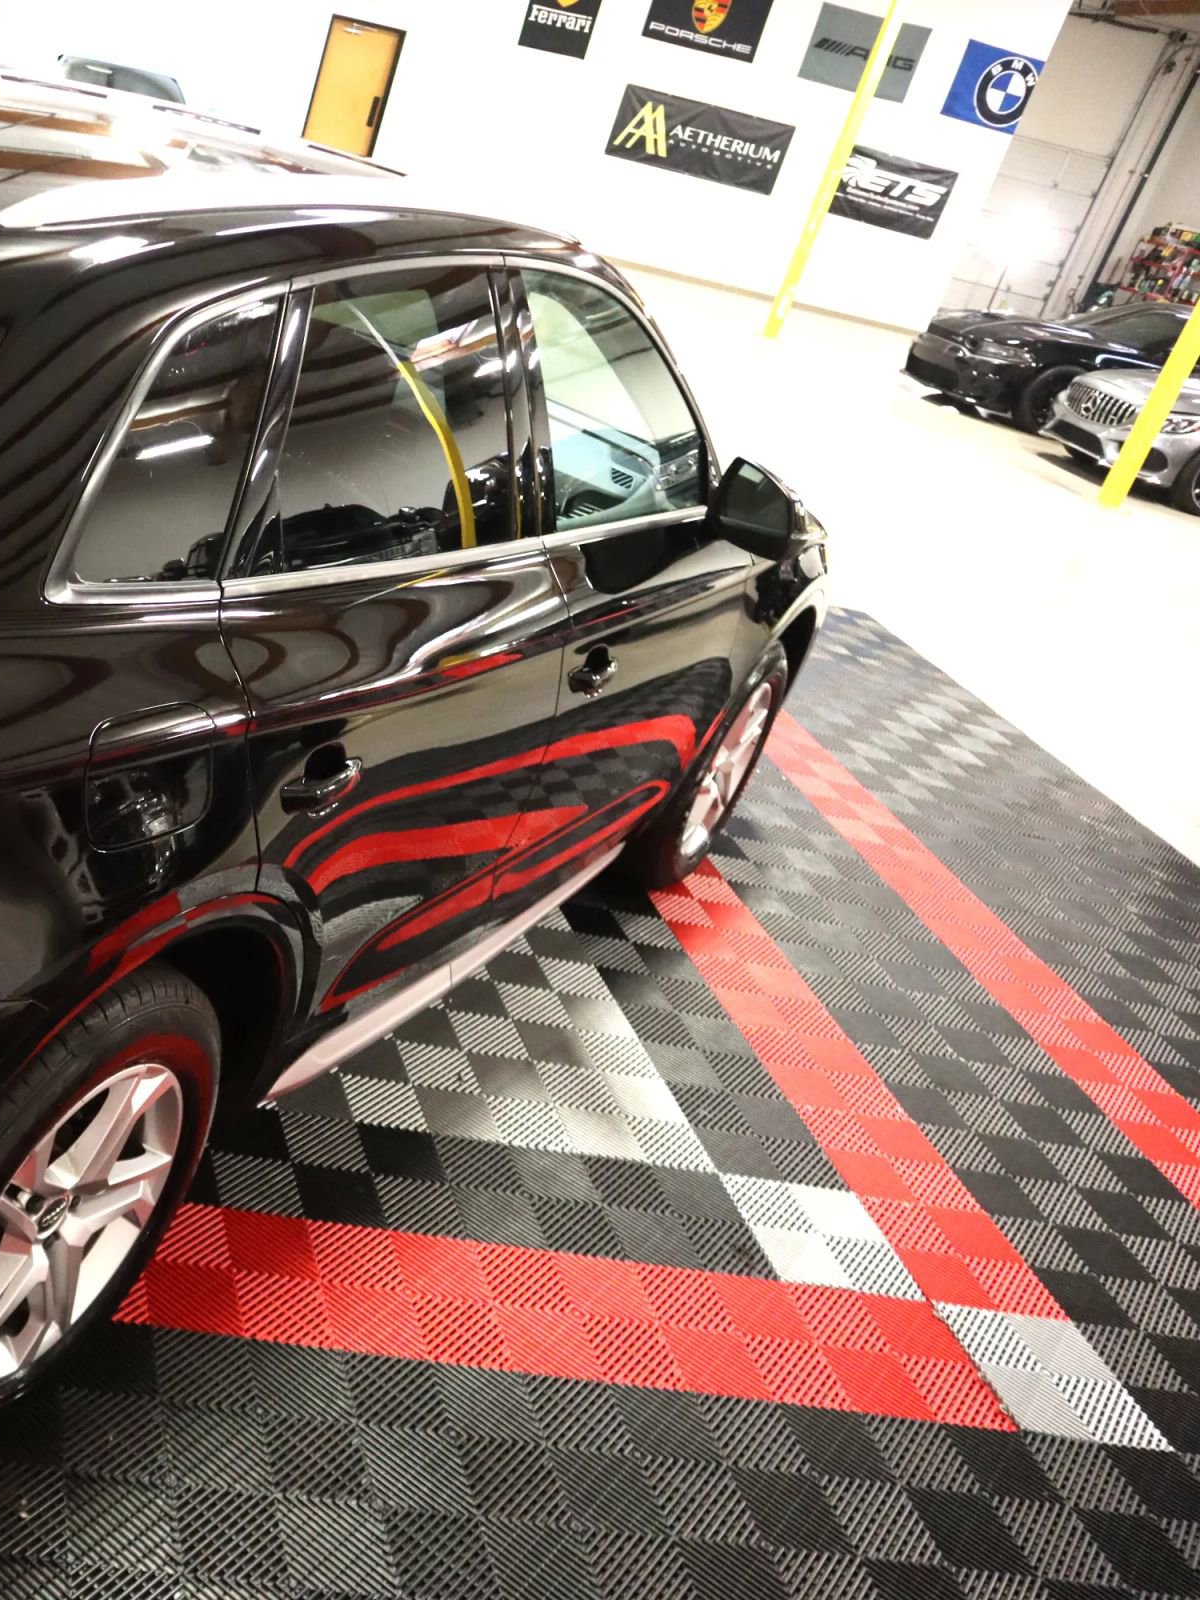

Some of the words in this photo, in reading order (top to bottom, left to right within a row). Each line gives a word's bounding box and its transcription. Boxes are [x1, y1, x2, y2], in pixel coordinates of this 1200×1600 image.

[528, 5, 593, 33] Ferrari
[649, 21, 752, 54] PORSCHE
[843, 45, 916, 71] AG
[991, 59, 1036, 87] BMW
[669, 124, 781, 163] AETHERIUM
